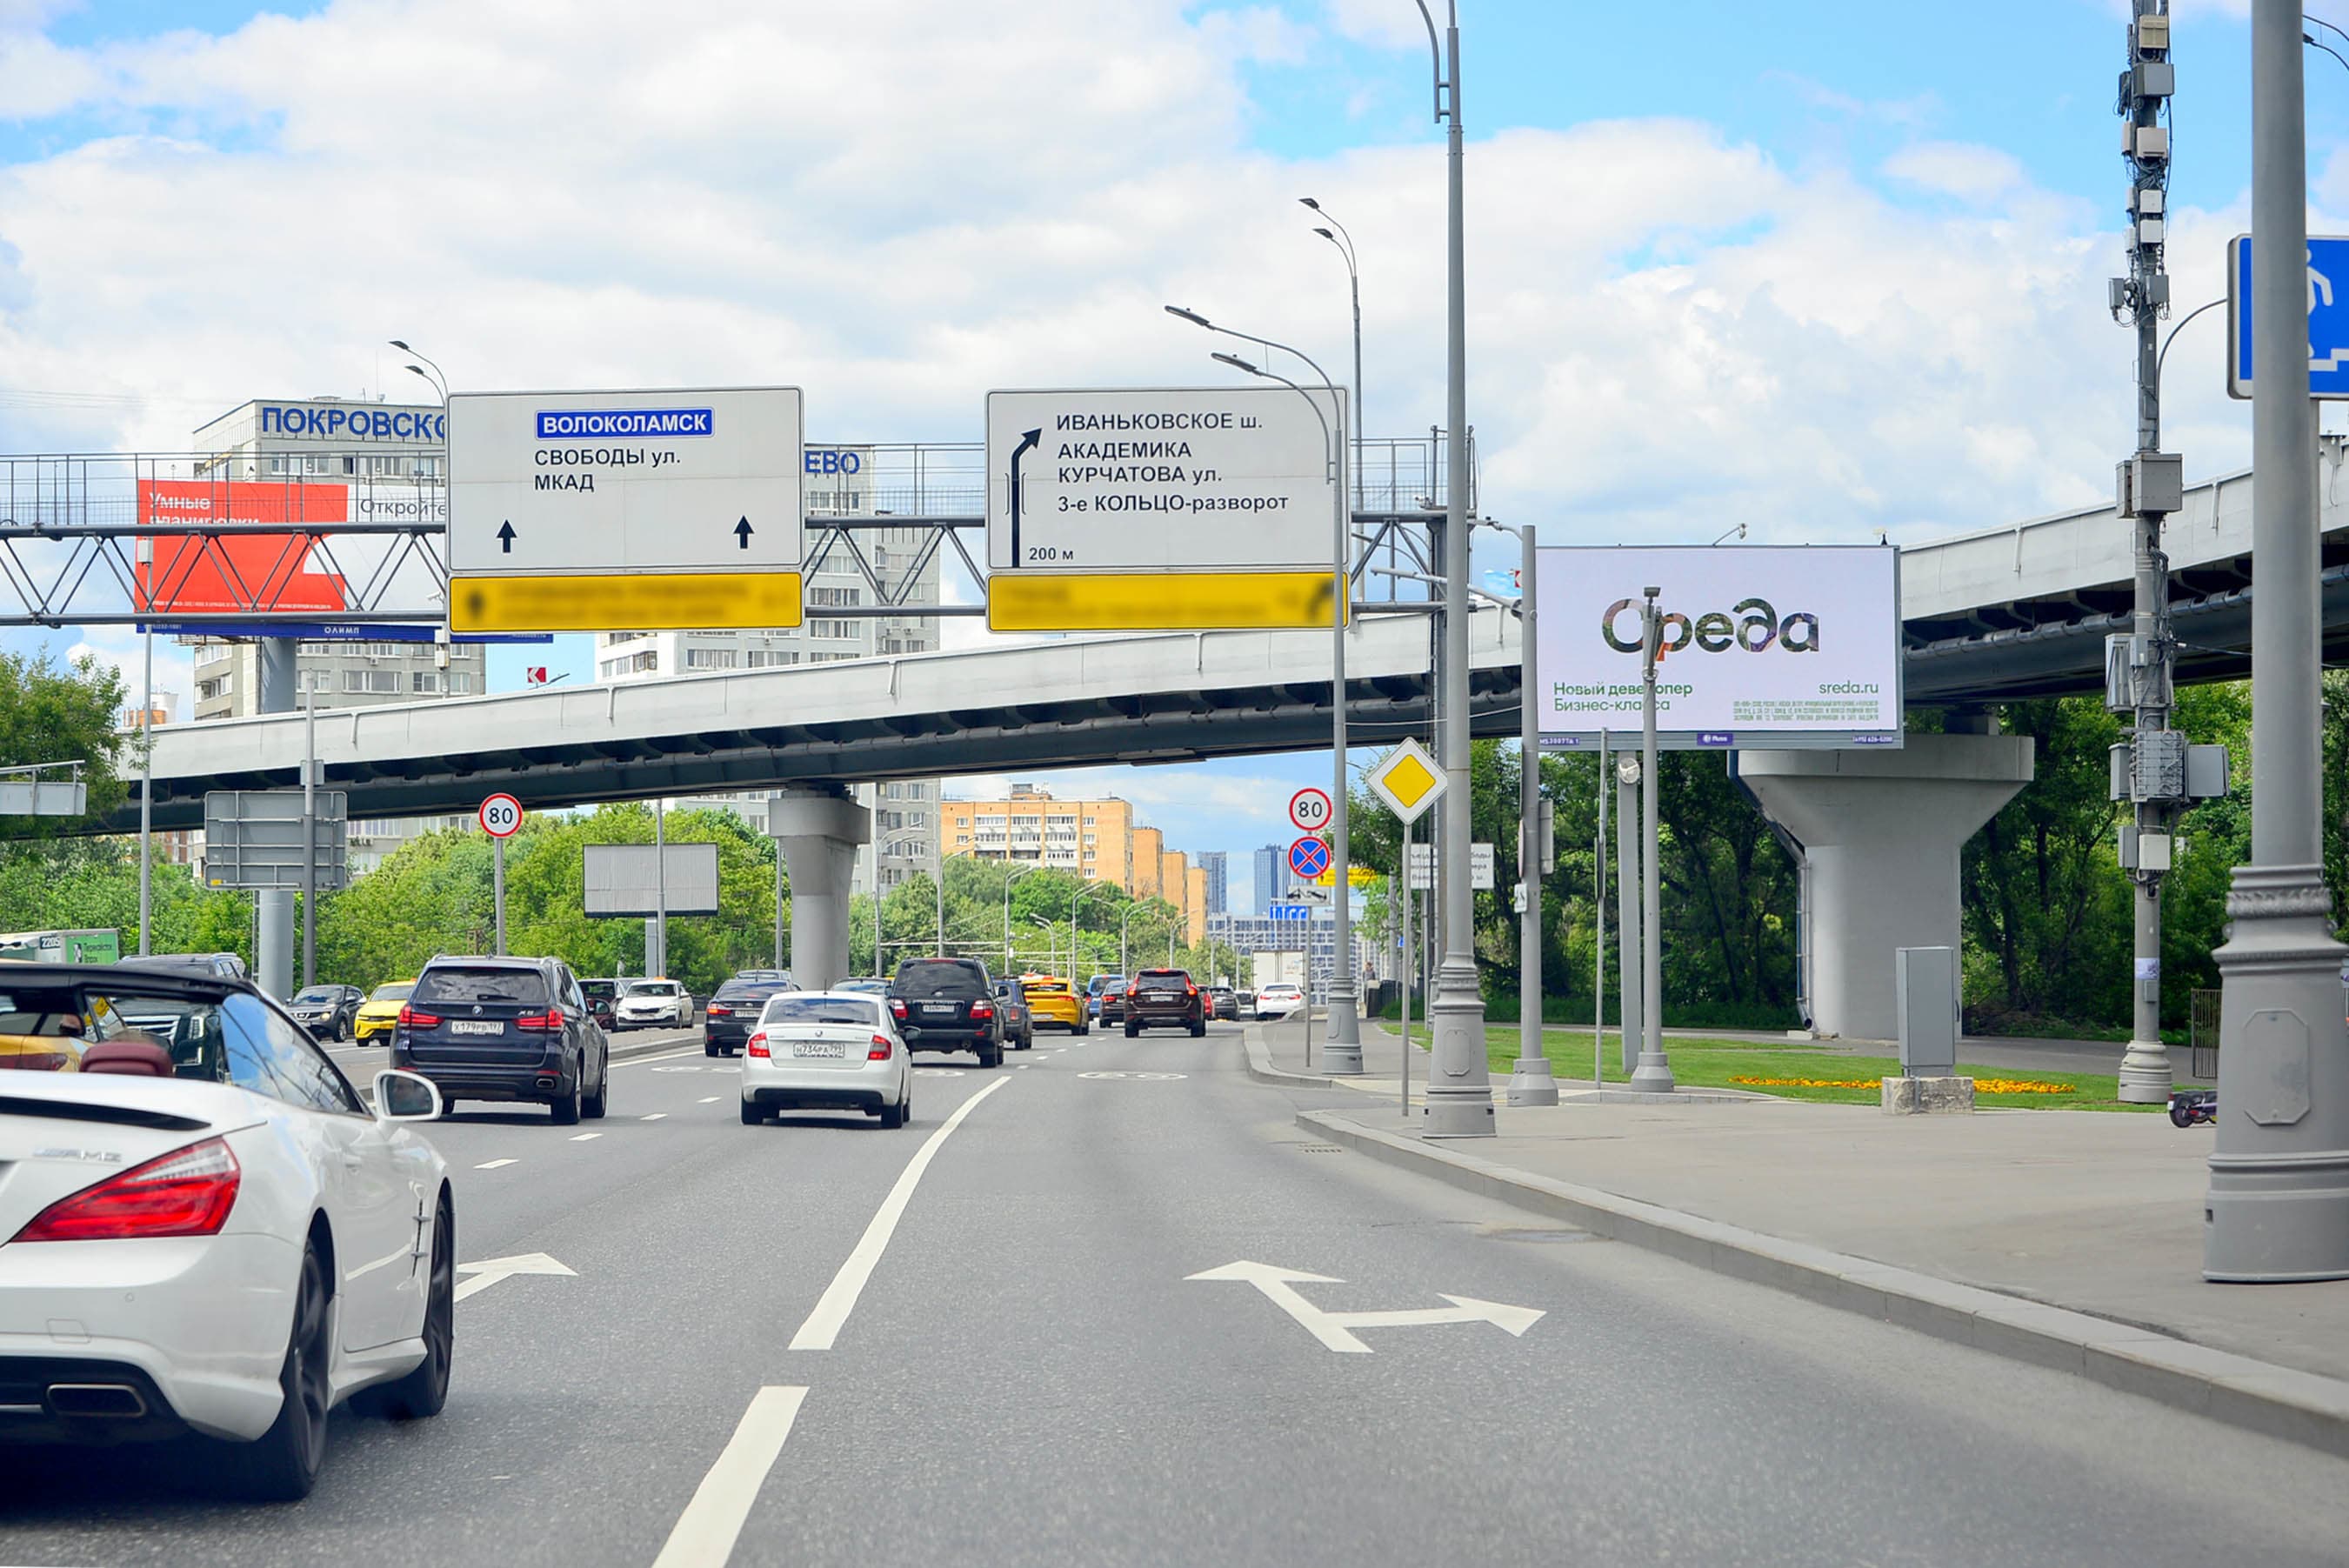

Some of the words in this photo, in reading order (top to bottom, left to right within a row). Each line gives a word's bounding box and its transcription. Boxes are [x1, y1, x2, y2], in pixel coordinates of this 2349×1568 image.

[544, 414, 706, 433] ВОЛОКОЛАМСК
[1057, 413, 1233, 430] ИВАНЬКОВСКОЕ
[1240, 417, 1263, 429] ш.
[535, 448, 644, 467] СВОБОДЫ
[651, 450, 680, 467] ул.
[1058, 442, 1191, 461] АКАДЕМИКА
[535, 474, 594, 492] МКАД
[1058, 466, 1186, 483] КУРЧАТОВА
[1191, 469, 1222, 484] ул.
[149, 492, 210, 510] Умные
[1058, 496, 1087, 511] 3-е
[1094, 495, 1288, 513] КОЛЬЦО-разворот
[1029, 547, 1057, 560] 200
[1062, 550, 1073, 560] м
[1553, 681, 1605, 696] Новый
[1608, 684, 1693, 697] девеопер
[1818, 680, 1879, 694] sreda.ru
[1554, 697, 1671, 711] Бизнес-класа
[489, 807, 513, 824] 80
[1298, 801, 1323, 817] 80
